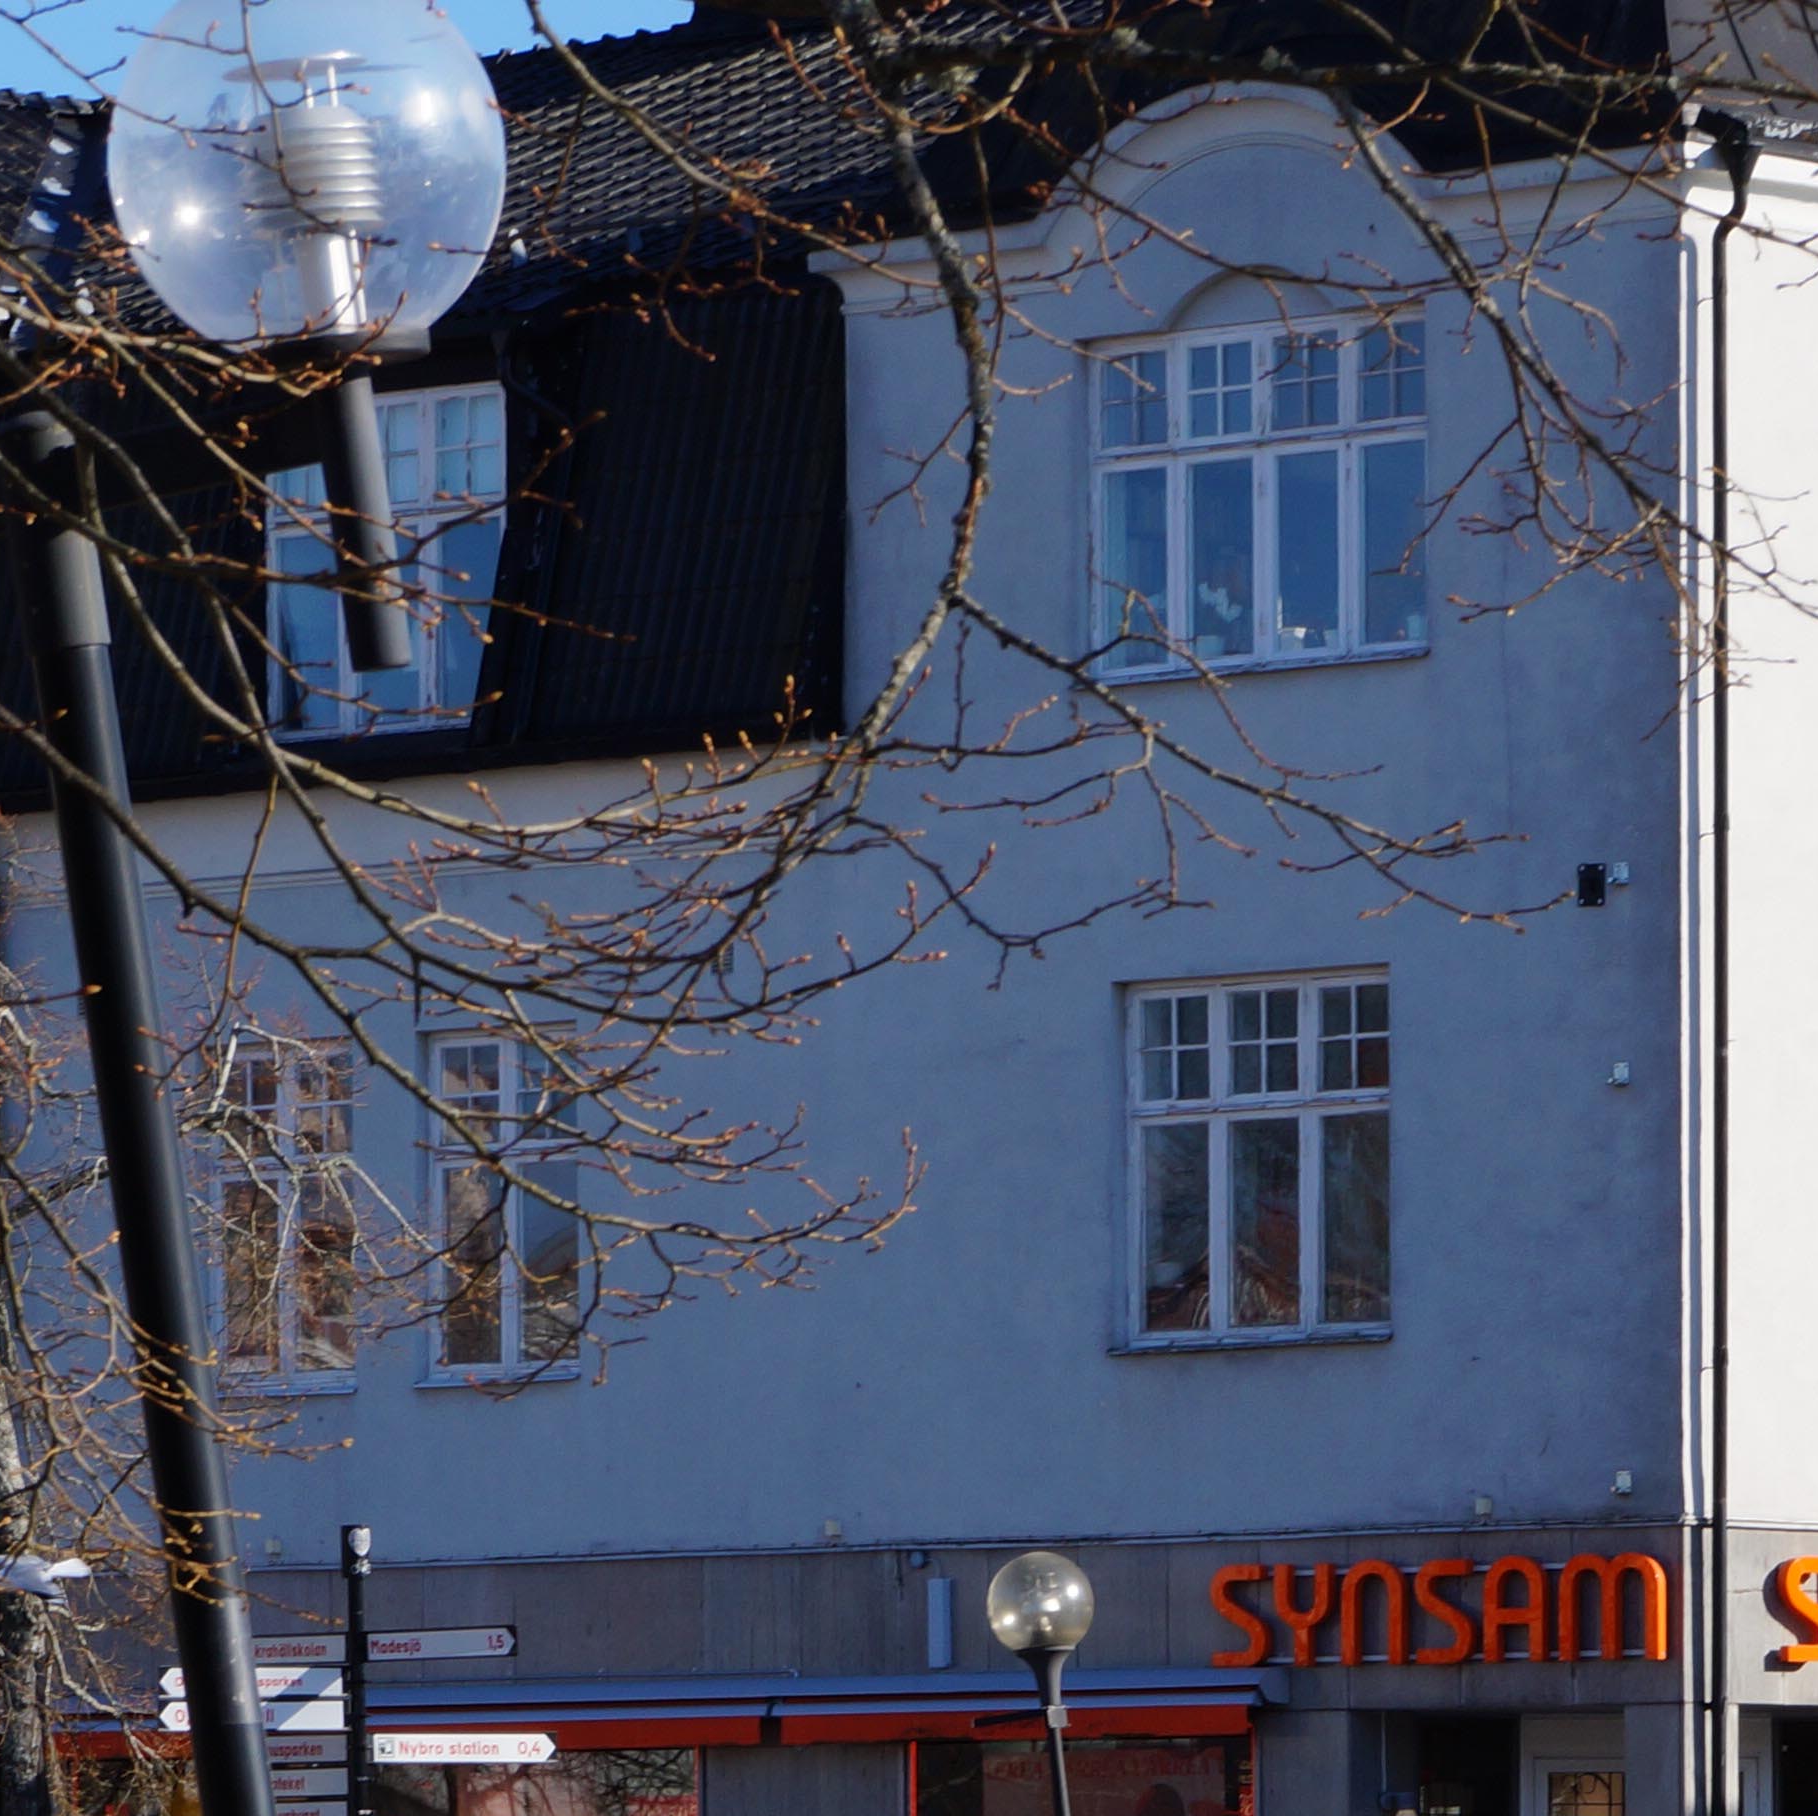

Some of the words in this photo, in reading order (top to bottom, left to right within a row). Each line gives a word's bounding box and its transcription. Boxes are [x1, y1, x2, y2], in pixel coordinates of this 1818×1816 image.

[1210, 1552, 1668, 1669] SYNSAM
[370, 1636, 421, 1656] Madesjö
[487, 1634, 505, 1650] 1,5
[398, 1741, 445, 1761] Nybro
[448, 1740, 500, 1756] station
[517, 1741, 542, 1760] 0,4
